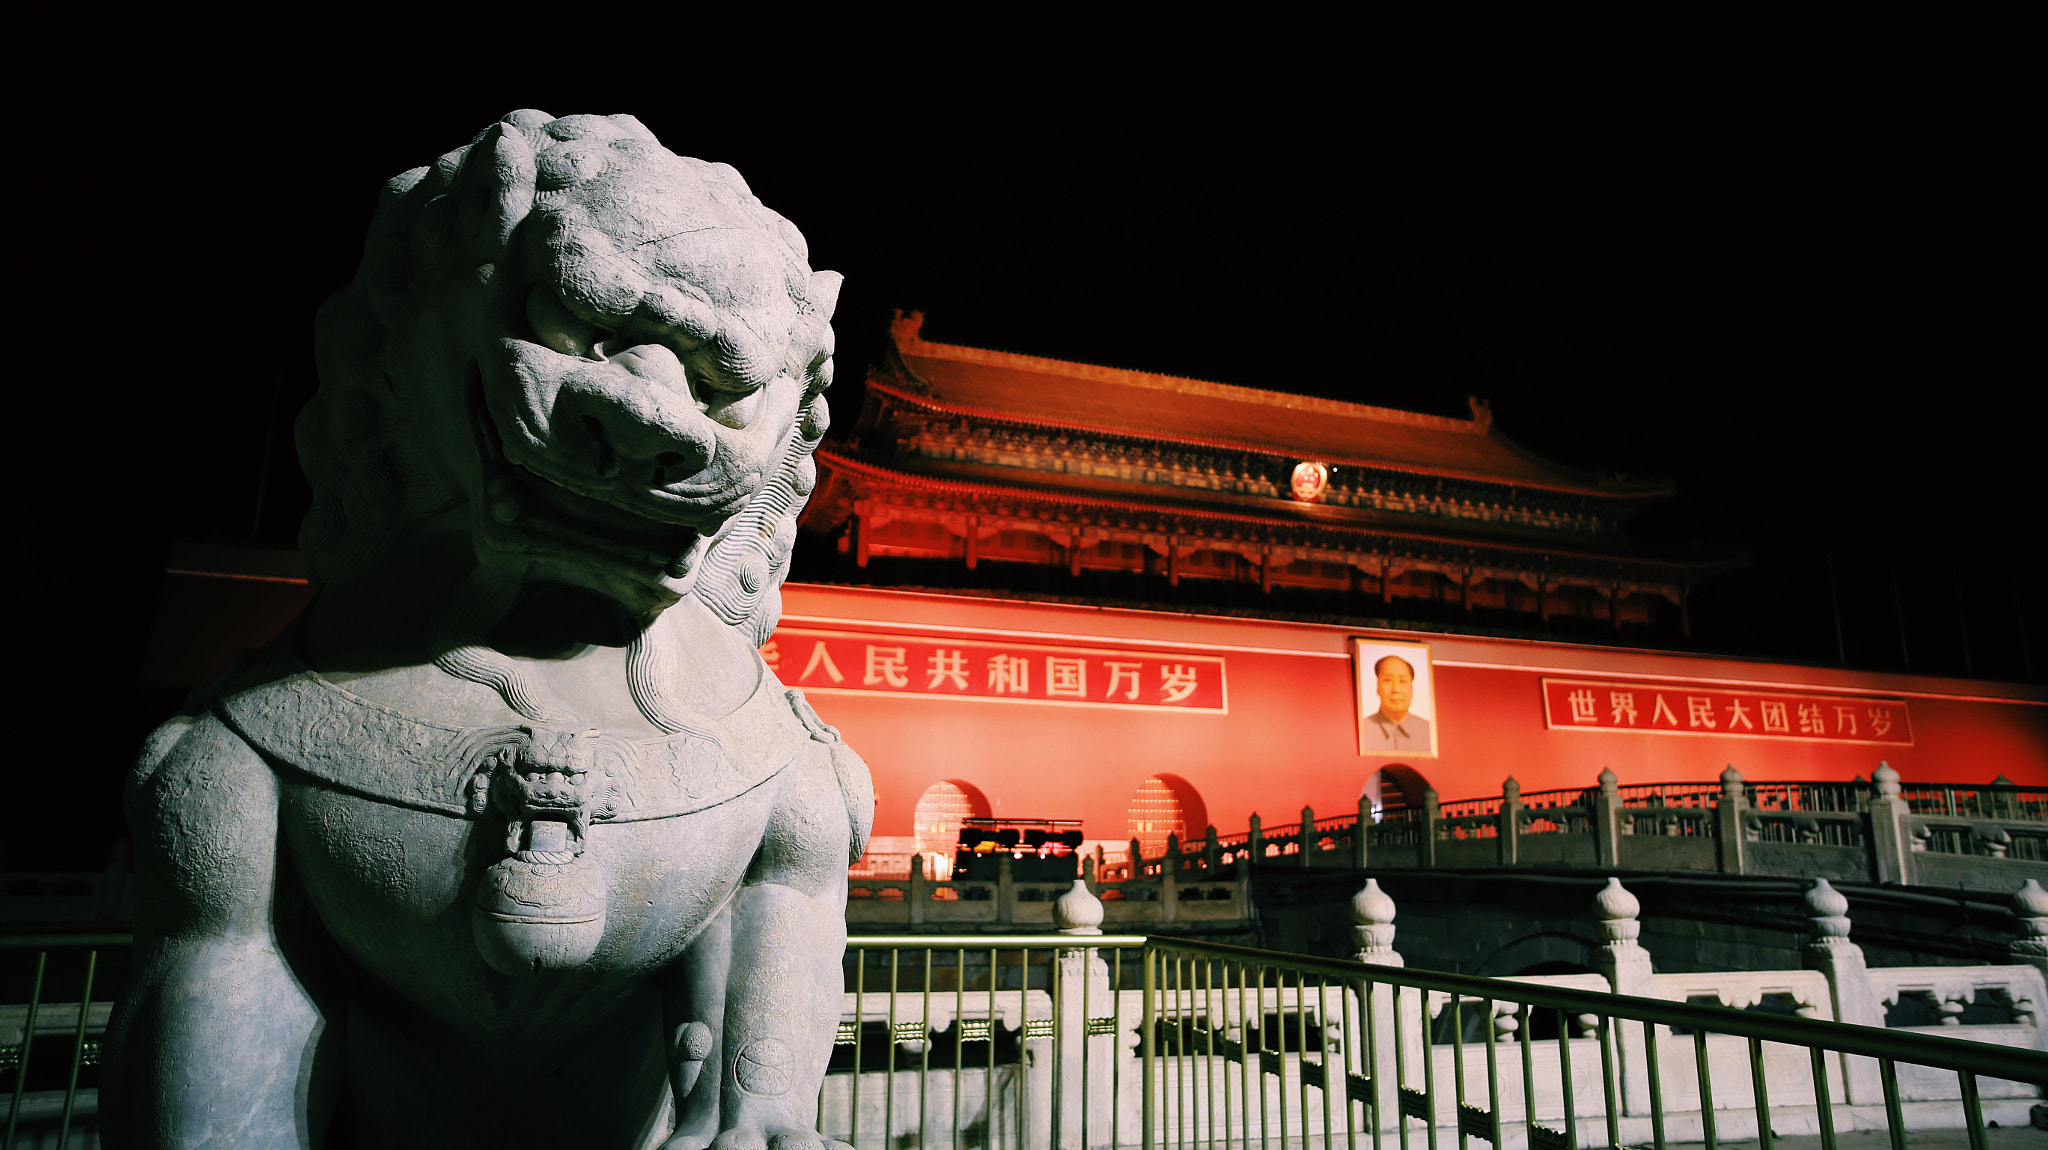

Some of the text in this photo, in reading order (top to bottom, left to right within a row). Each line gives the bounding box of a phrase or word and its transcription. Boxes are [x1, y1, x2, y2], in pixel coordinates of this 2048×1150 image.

[1568, 689, 1892, 737] 世界人民大团结万岁
